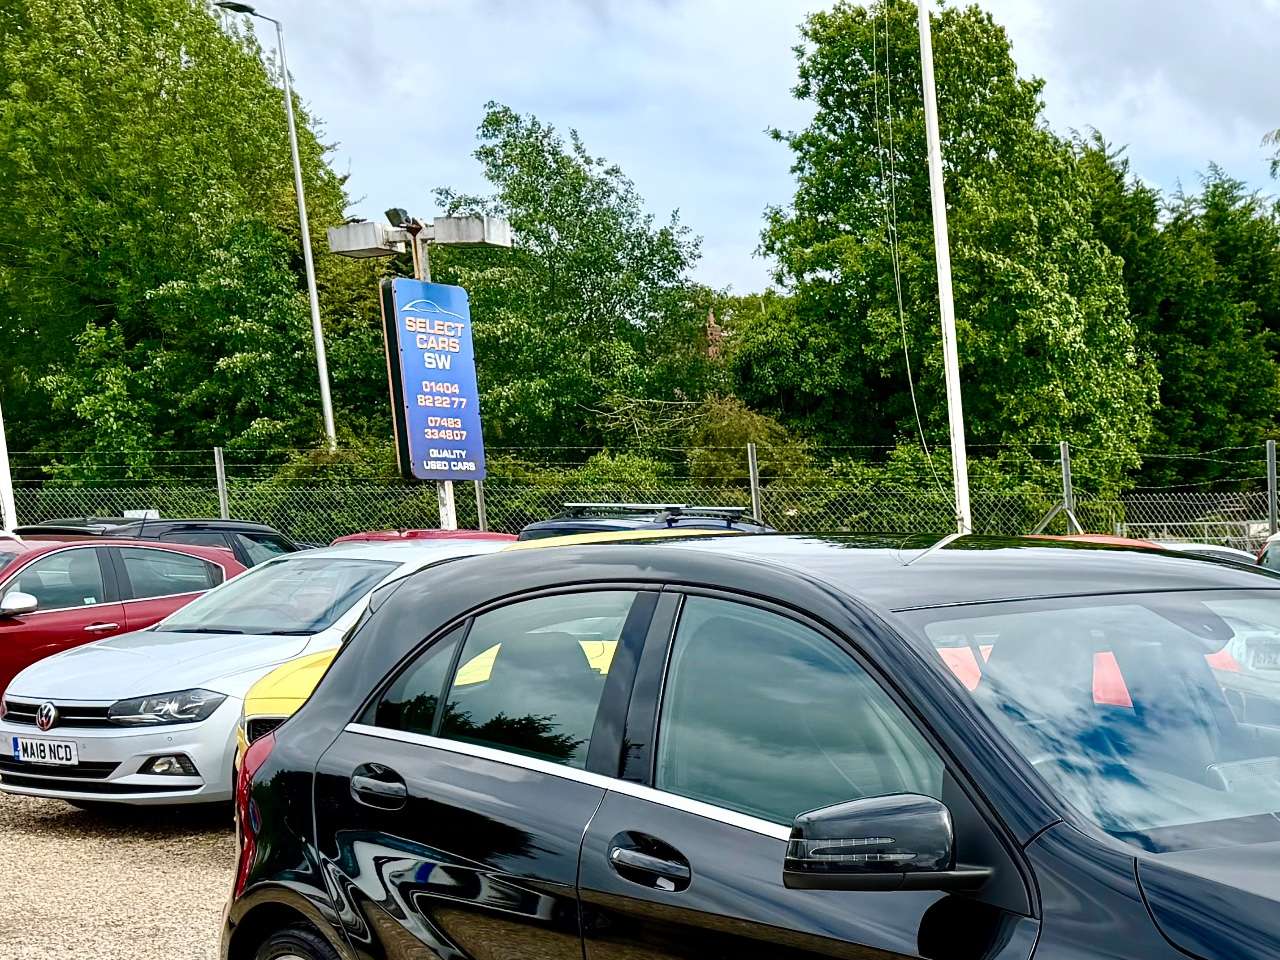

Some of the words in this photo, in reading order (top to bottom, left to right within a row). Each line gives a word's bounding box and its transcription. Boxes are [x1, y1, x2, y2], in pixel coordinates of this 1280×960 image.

[405, 316, 465, 337] SELECT
[416, 334, 460, 353] CARS
[423, 352, 451, 370] SW
[422, 380, 460, 394] 01404
[424, 428, 467, 441] 334807
[429, 448, 467, 459] QUALITY
[423, 460, 449, 470] USED
[451, 461, 476, 471] CARS
[21, 741, 47, 760] MA18
[48, 743, 72, 761] NCD
